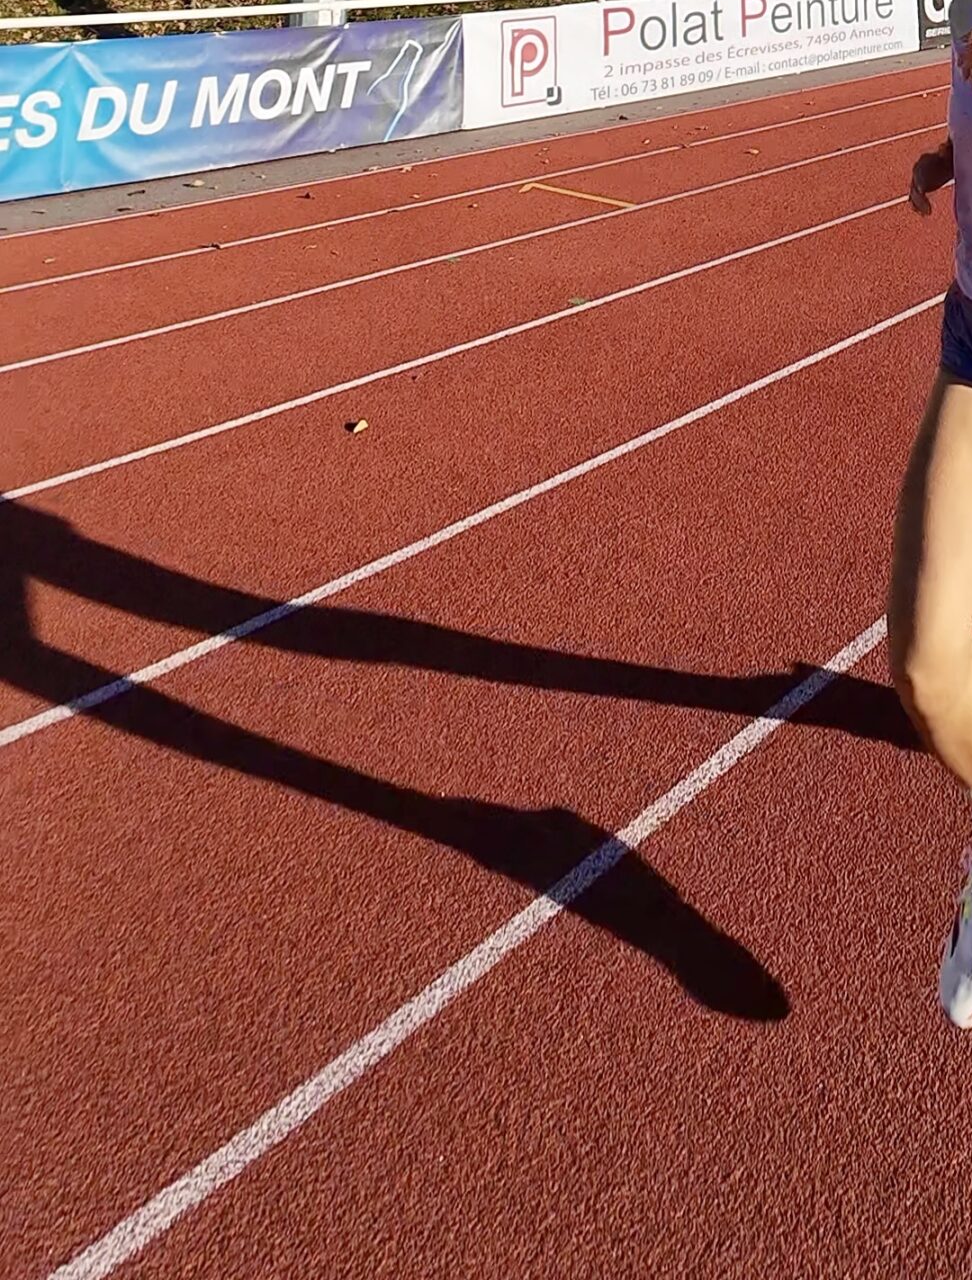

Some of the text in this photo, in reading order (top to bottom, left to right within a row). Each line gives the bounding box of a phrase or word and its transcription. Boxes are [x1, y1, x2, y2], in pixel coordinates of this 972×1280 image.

[603, 0, 724, 56] Polat
[604, 26, 895, 78] 2 impasse des Écrevisses, 74960 Annecy
[590, 86, 610, 101] Tél
[621, 82, 638, 97] 06
[641, 79, 657, 93] 73
[661, 76, 675, 90] 81
[680, 73, 695, 87] 89
[698, 70, 713, 84] 09
[724, 62, 760, 79] E-mail
[768, 40, 903, 72] contact@polatpeinture.com
[77, 79, 178, 141] DU
[190, 60, 372, 128] MONT
